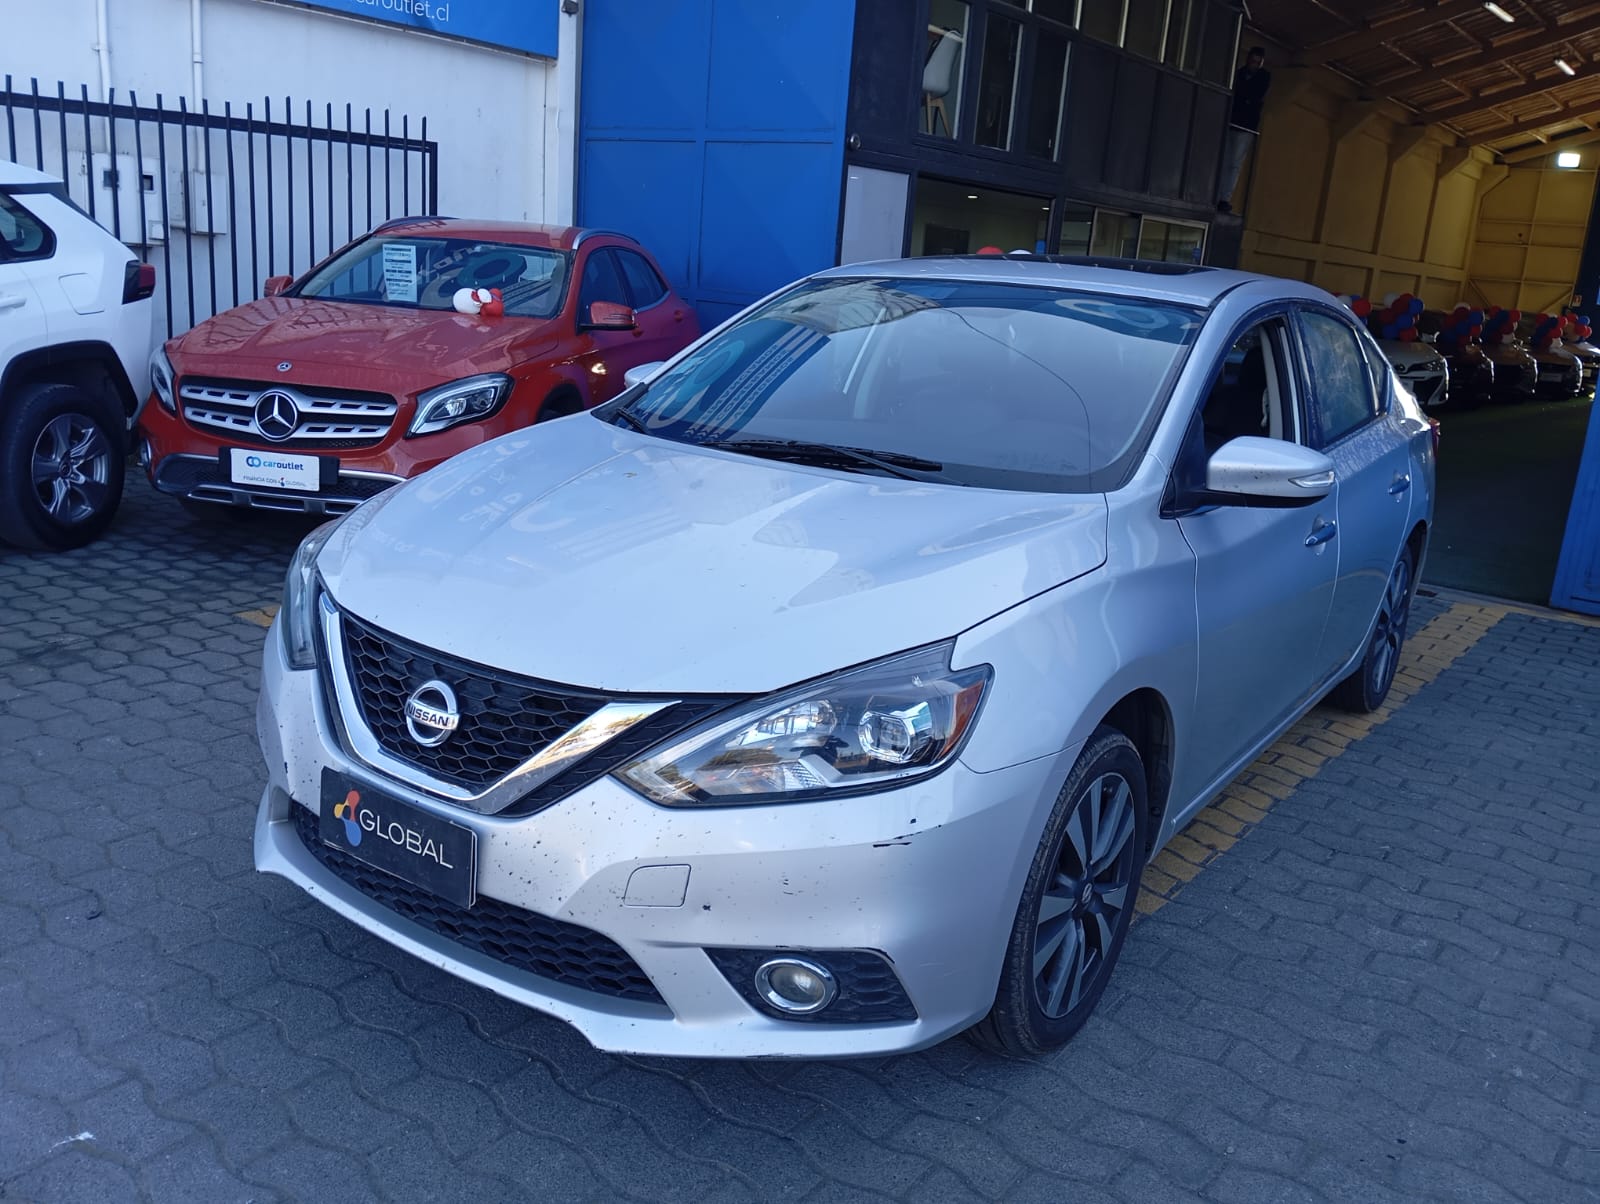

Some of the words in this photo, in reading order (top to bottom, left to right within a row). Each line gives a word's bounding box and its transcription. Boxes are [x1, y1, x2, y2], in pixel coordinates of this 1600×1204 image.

[263, 461, 304, 471] caroutlet
[405, 701, 449, 727] NISSAN
[359, 808, 454, 869] GLOBAL
